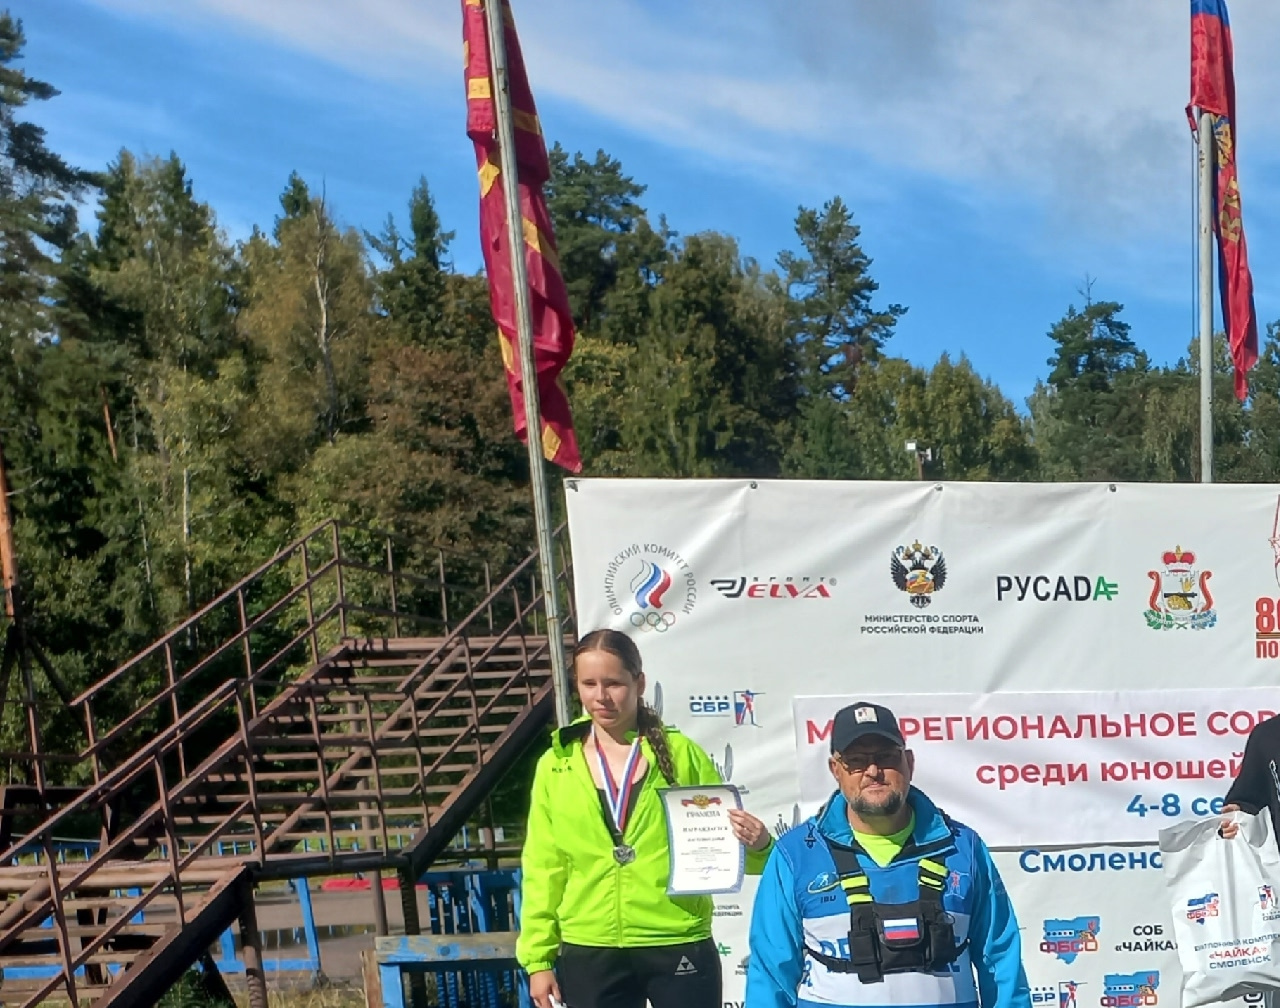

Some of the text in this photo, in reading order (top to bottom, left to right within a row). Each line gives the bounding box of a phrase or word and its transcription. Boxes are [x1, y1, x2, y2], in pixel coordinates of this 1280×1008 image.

[604, 543, 697, 616] ОЛИМПИЙСКИЙ КОМИТЕТ РОССИИ
[864, 613, 980, 624] МИНИСТЕРСТВО СПОРТА
[860, 624, 984, 635] РОССИЙСКОЙ ФЕДЕРАЦИИ
[689, 701, 731, 713] СБР
[806, 711, 1197, 744] МРЕГИОНАЛЬНОЕ
[976, 751, 1243, 790] среди юношей
[1126, 793, 1181, 817] 4-8
[1019, 849, 1164, 873] Смоленс
[1133, 925, 1163, 936] СОБ
[1040, 941, 1098, 953] ФБСО
[1209, 954, 1271, 970] СМОЛЕНСК
[1033, 993, 1055, 1002] БР
[1100, 994, 1158, 1007] ФБСО
